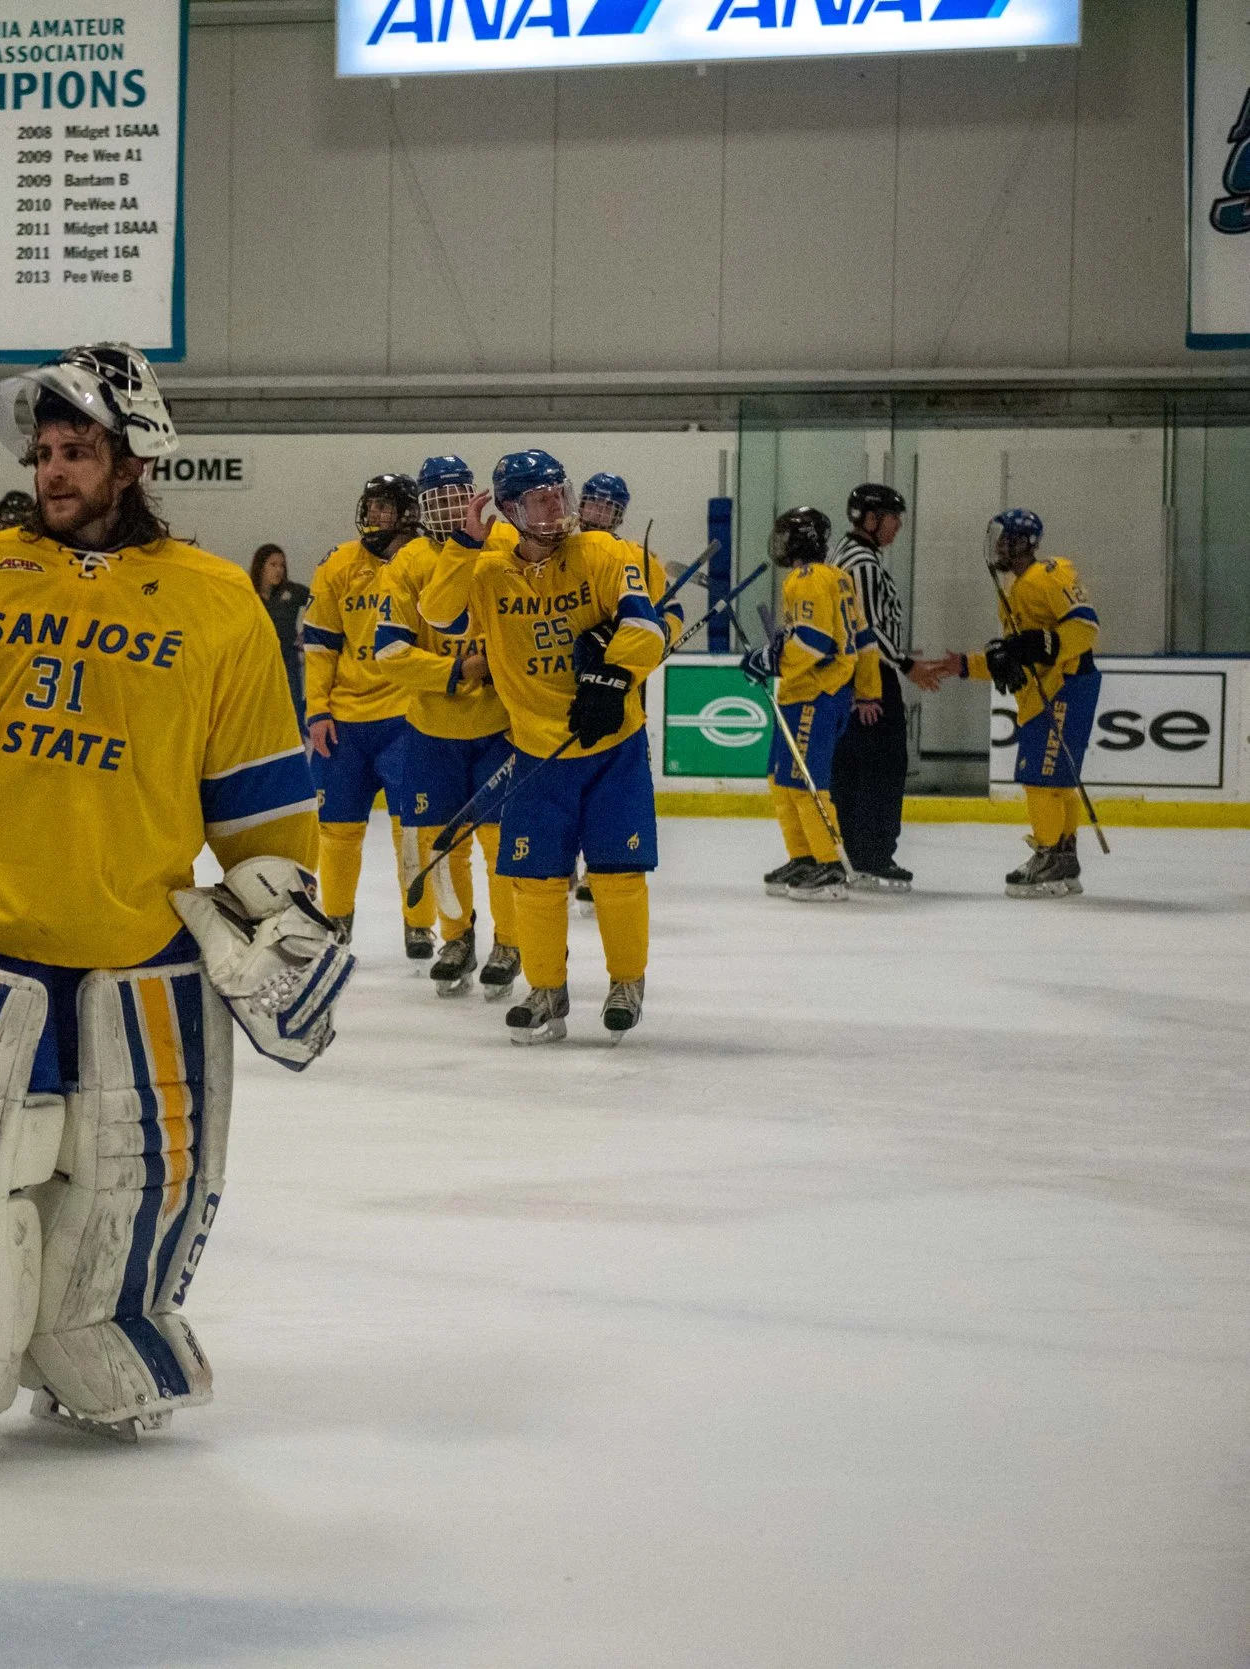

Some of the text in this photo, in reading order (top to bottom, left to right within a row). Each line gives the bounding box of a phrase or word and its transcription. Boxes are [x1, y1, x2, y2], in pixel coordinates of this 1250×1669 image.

[29, 18, 125, 37] AMATEUR
[64, 125, 110, 141] Midget
[115, 123, 160, 138] 16AAA
[17, 148, 142, 164] 2009 Pee Wee A1
[17, 172, 130, 189] 2009 Bantam B
[16, 196, 139, 213] 2010 PeeWee AA
[16, 220, 158, 238] 2011 Midget 18AAA
[16, 245, 140, 262] 2011 Midget 16A
[15, 269, 132, 284] 2013 Pee Wee B
[152, 458, 243, 482] HOME
[345, 594, 379, 612] SAN
[499, 580, 592, 615] SAN JOSÉ
[532, 614, 575, 651] 25
[76, 619, 183, 669] JOSÉ
[24, 656, 86, 714] 31
[579, 673, 628, 690] RUE
[1, 721, 126, 771] STATE
[171, 1192, 221, 1307] CCM
